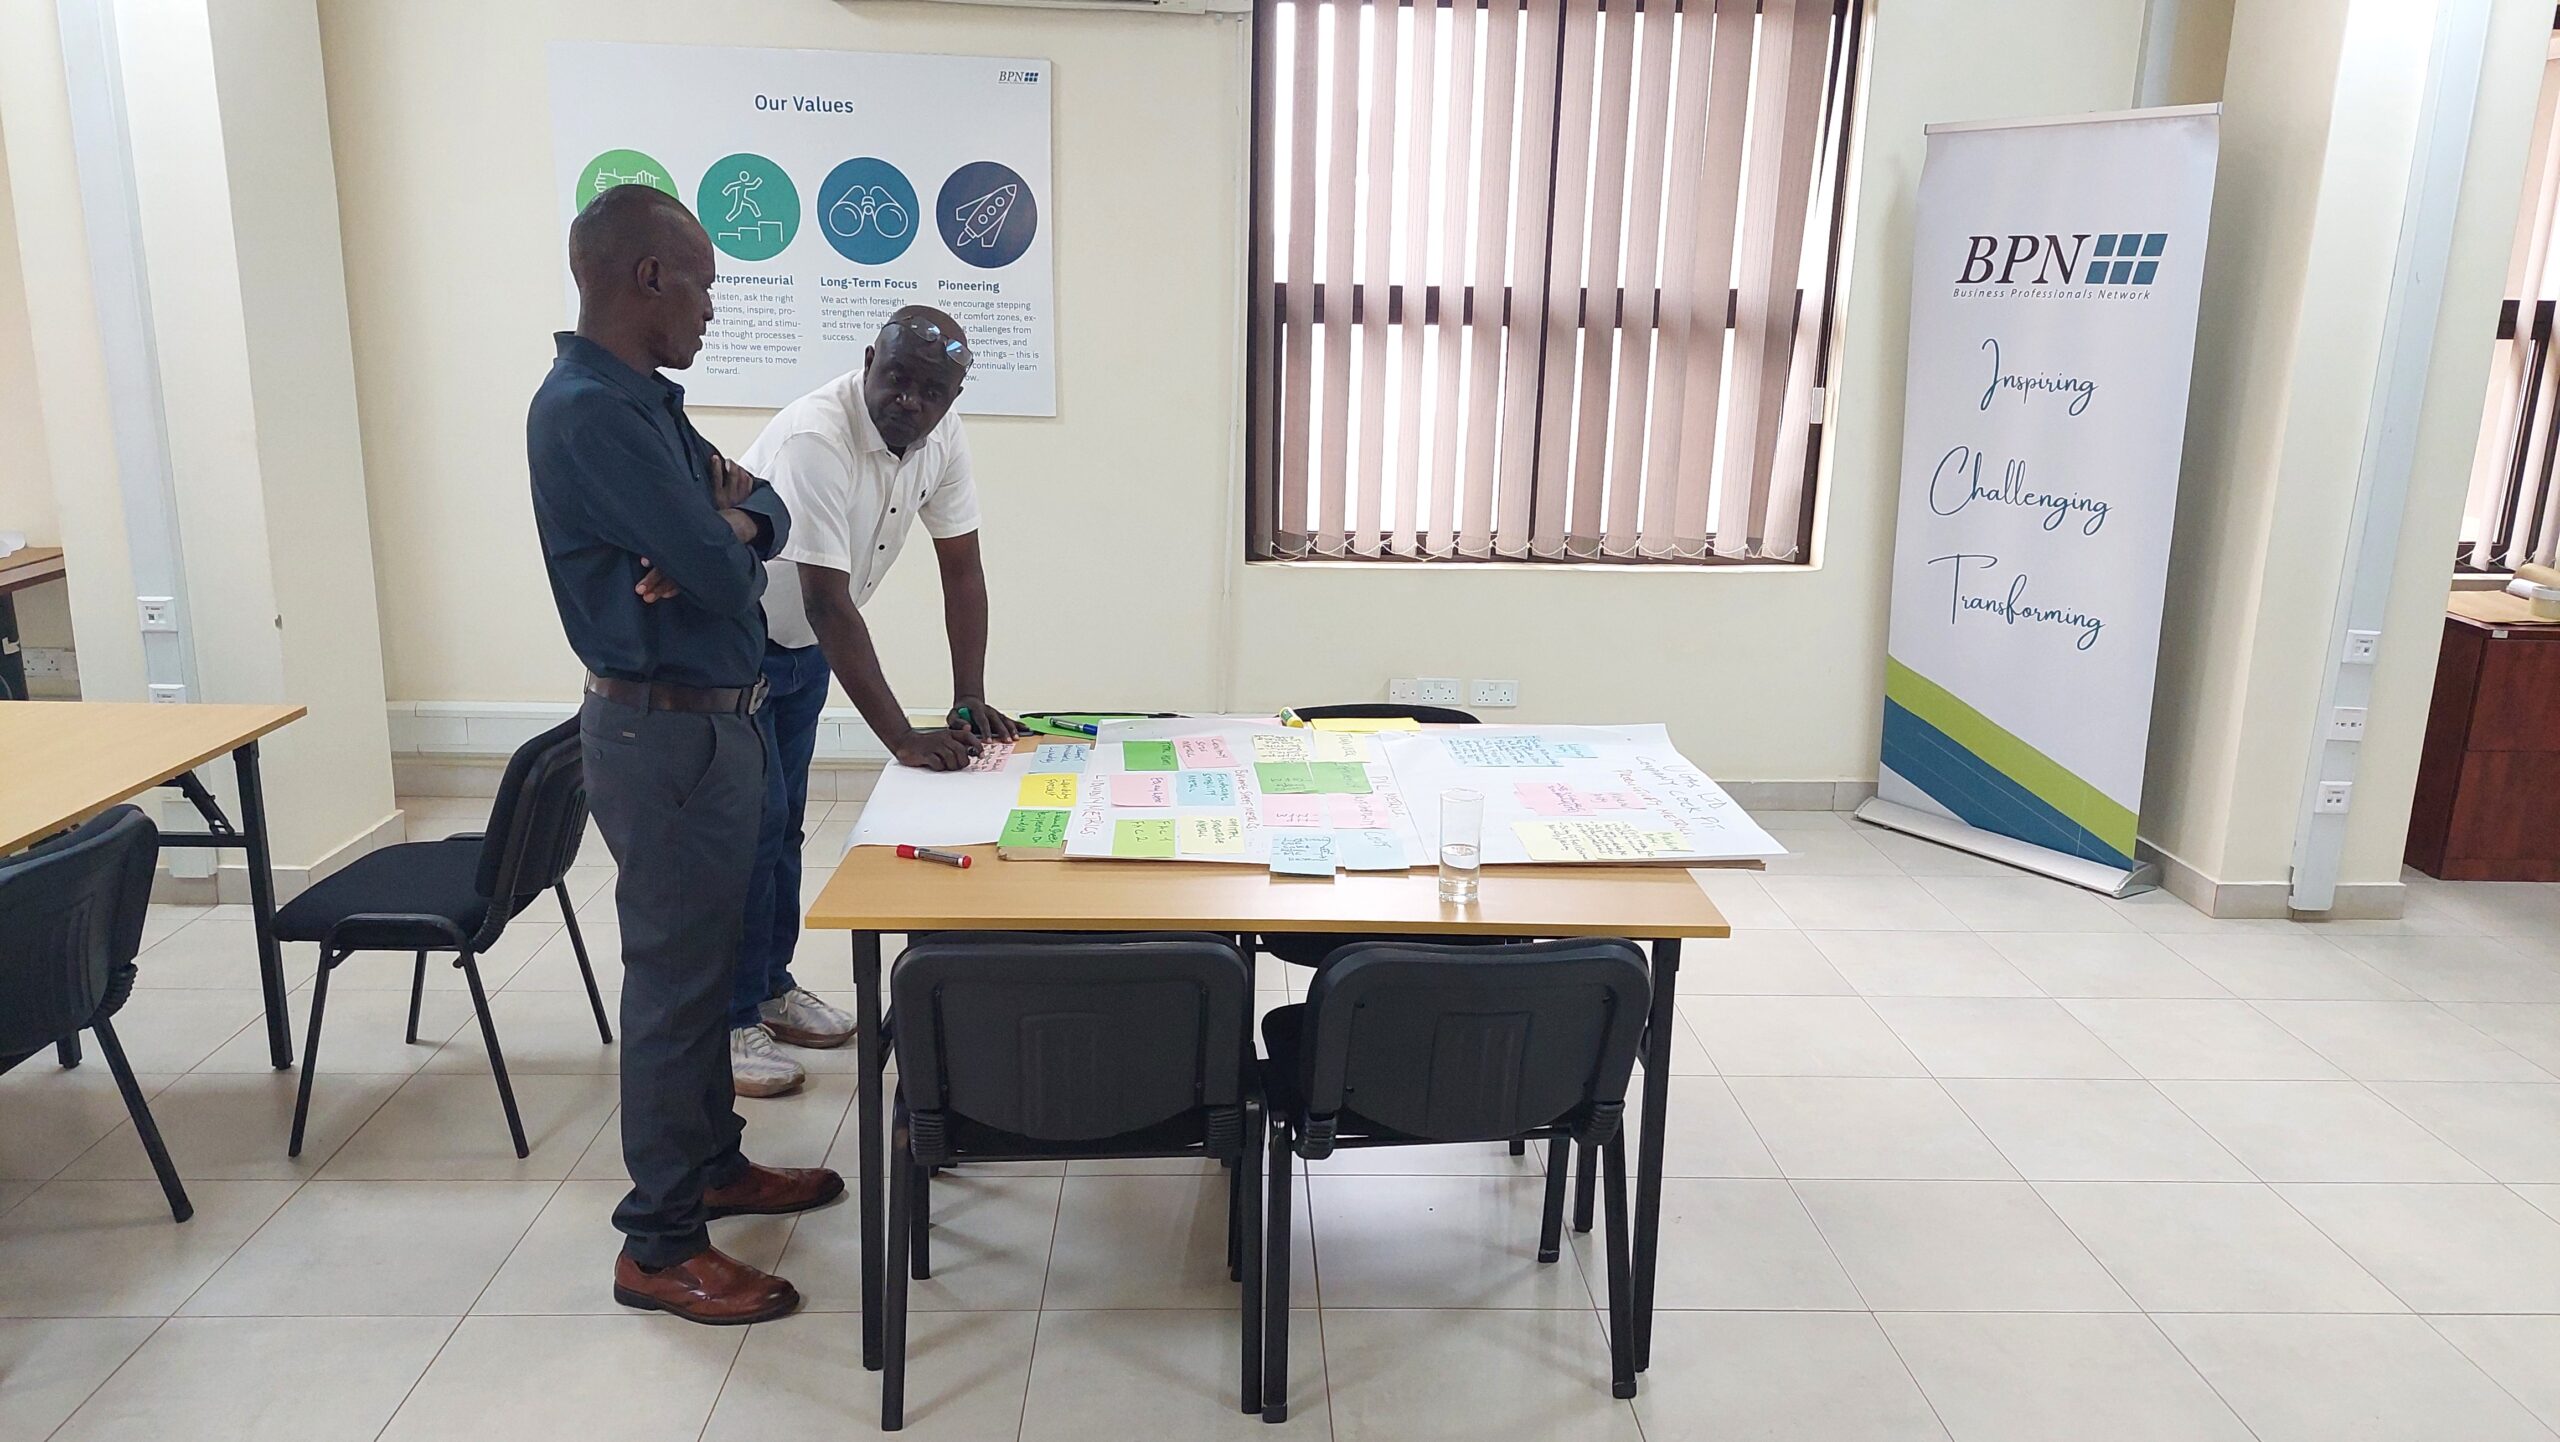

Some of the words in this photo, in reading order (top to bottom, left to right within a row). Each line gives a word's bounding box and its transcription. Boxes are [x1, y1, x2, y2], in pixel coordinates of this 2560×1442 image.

[999, 71, 1024, 82] BPN
[755, 94, 788, 111] Our
[793, 96, 854, 113] Values
[1955, 234, 2091, 285] BPN
[716, 274, 794, 286] trepreneurial
[820, 276, 881, 290] Long-Term
[884, 278, 918, 289] Focus
[938, 280, 1000, 294] Pioneering
[717, 292, 742, 302] listen,
[743, 293, 758, 302] ask
[760, 293, 774, 302] the
[775, 294, 794, 304] right
[1953, 288, 2005, 298] Business
[2010, 288, 2092, 299] Professionals
[2098, 289, 2151, 300] Network
[820, 295, 834, 304] We
[850, 296, 868, 305] with
[938, 299, 951, 307] We
[953, 299, 995, 310] encourage
[996, 300, 1031, 311] stepping
[713, 305, 745, 315] estions,
[746, 305, 777, 316] inspire,
[778, 308, 796, 317] pro-
[821, 308, 865, 318] strengthen
[953, 311, 962, 320] of
[963, 312, 995, 321] comfort
[996, 314, 1022, 323] zones,
[722, 318, 756, 328] training,
[757, 319, 773, 327] and
[775, 318, 801, 328] stimu-
[822, 320, 835, 329] and
[838, 321, 861, 329] strive
[863, 321, 875, 330] for
[722, 330, 753, 340] thought
[755, 332, 796, 341] processes
[968, 325, 1011, 335] challenges
[1013, 326, 1032, 334] from
[822, 333, 857, 342] success.
[968, 338, 1011, 347] rspectives,
[1012, 338, 1028, 347] and
[705, 342, 720, 350] this
[722, 342, 729, 351] is
[730, 343, 747, 351] how
[763, 344, 801, 353] empower
[705, 355, 763, 364] entrepreneurs
[765, 356, 774, 364] to
[775, 357, 797, 365] move
[982, 350, 1008, 359] things
[1016, 351, 1031, 359] this
[1032, 351, 1040, 359] is
[706, 366, 740, 375] forward.
[972, 362, 1016, 373] continually
[1017, 363, 1038, 372] learn
[1980, 338, 2099, 416] Inspiring
[1929, 445, 2113, 536] Challenging
[1928, 553, 2106, 651] Transforming
